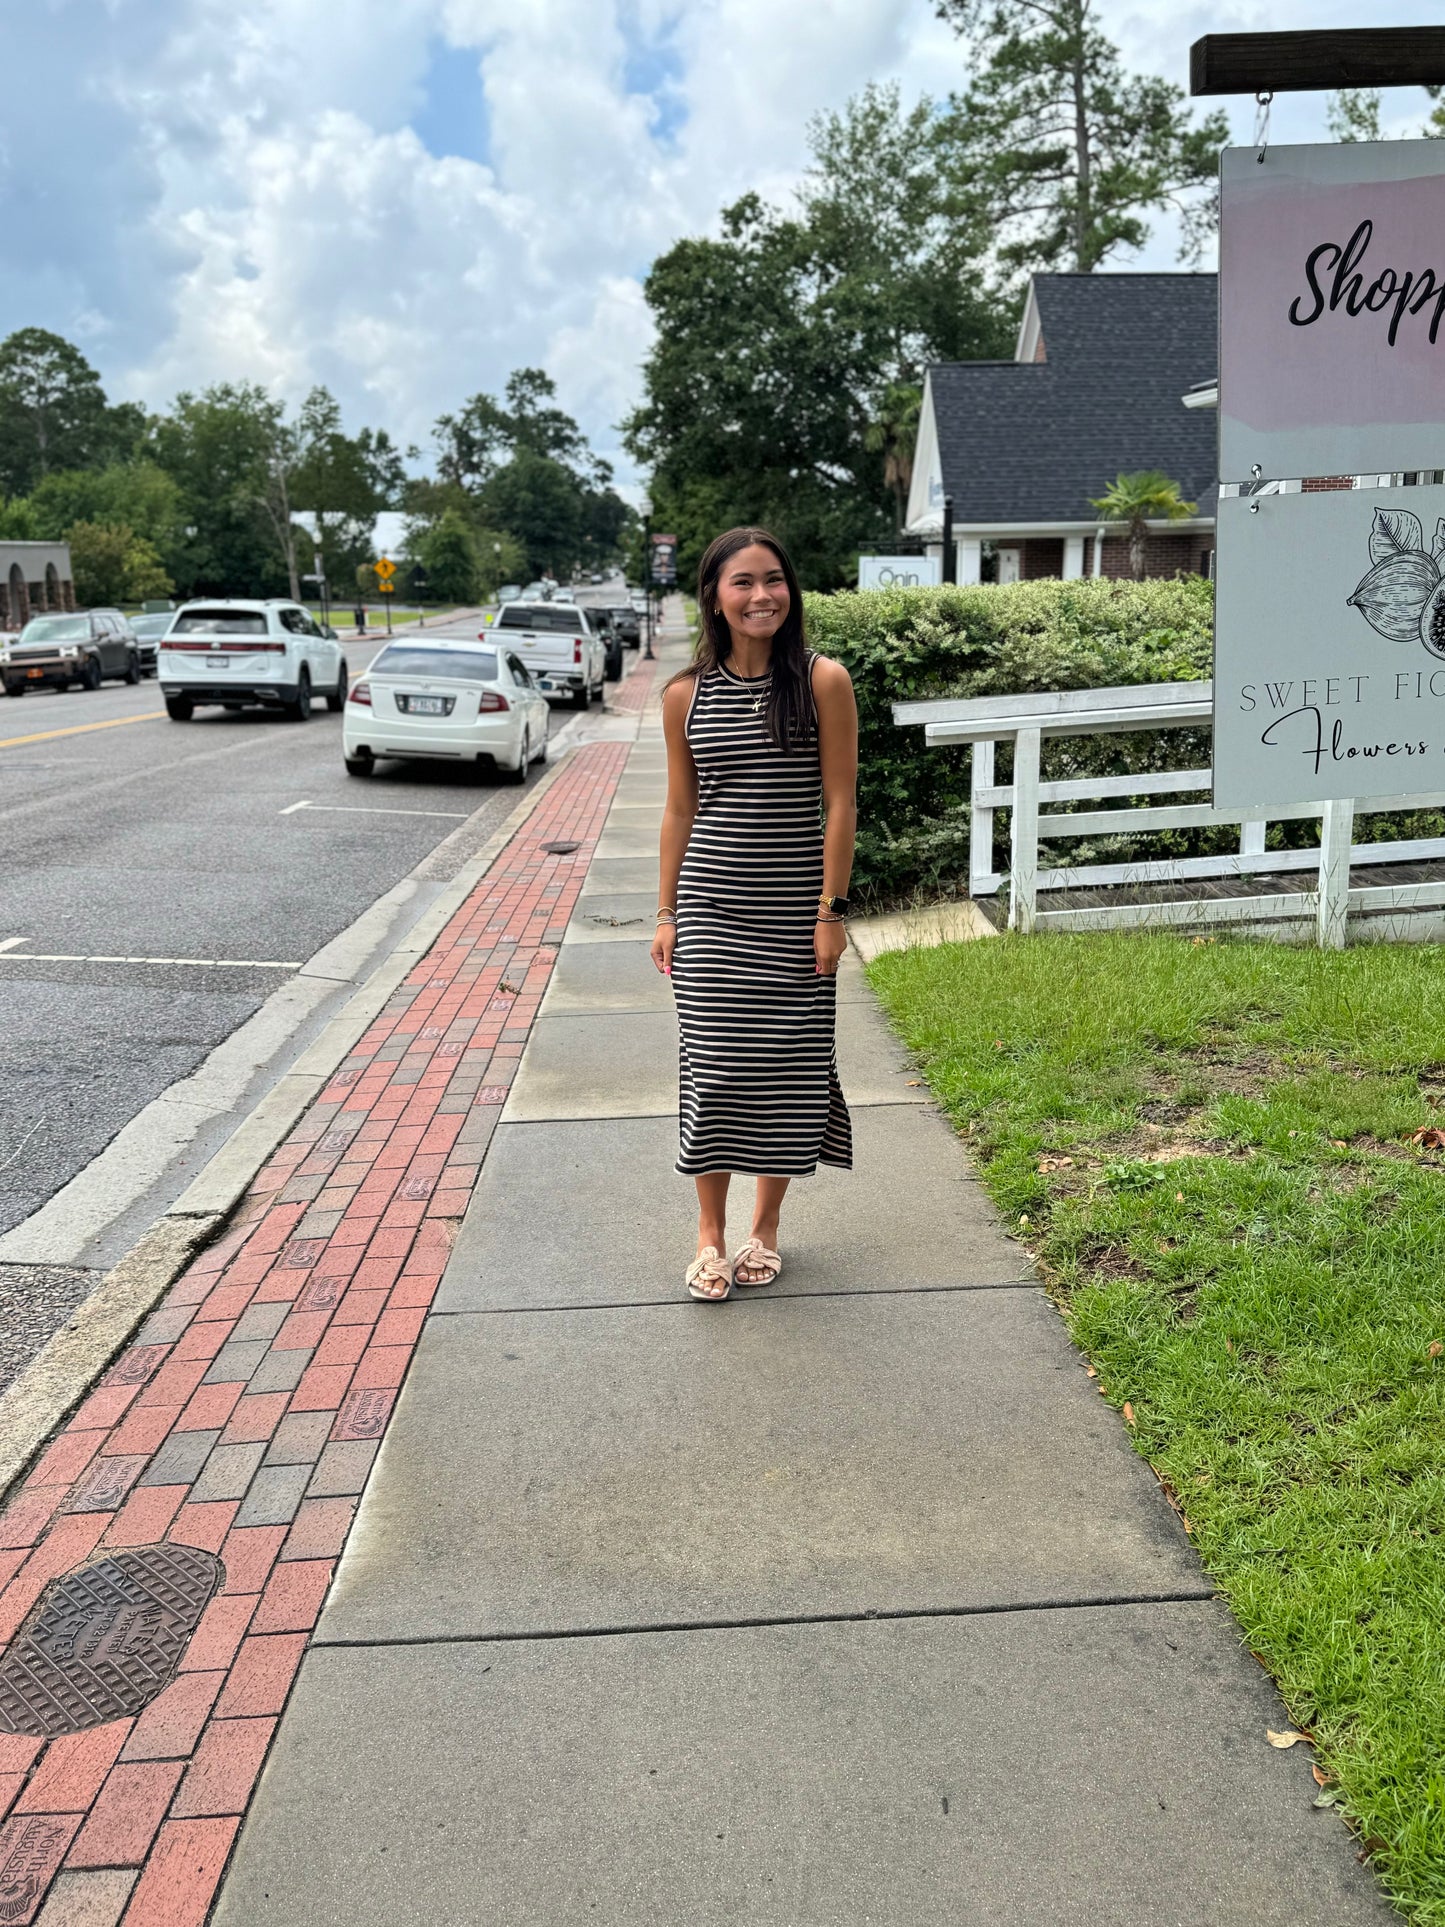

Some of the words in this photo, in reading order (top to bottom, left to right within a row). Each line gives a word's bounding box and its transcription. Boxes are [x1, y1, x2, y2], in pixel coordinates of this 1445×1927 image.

[1239, 675, 1370, 712] SWEET
[1261, 706, 1429, 775] Flowers
[49, 1607, 104, 1664] METER
[93, 1624, 111, 1638] 22
[106, 1610, 139, 1654] PATENTED
[118, 1604, 163, 1656] WATER
[1, 1820, 48, 1884] Augusta
[25, 1828, 65, 1873] North
